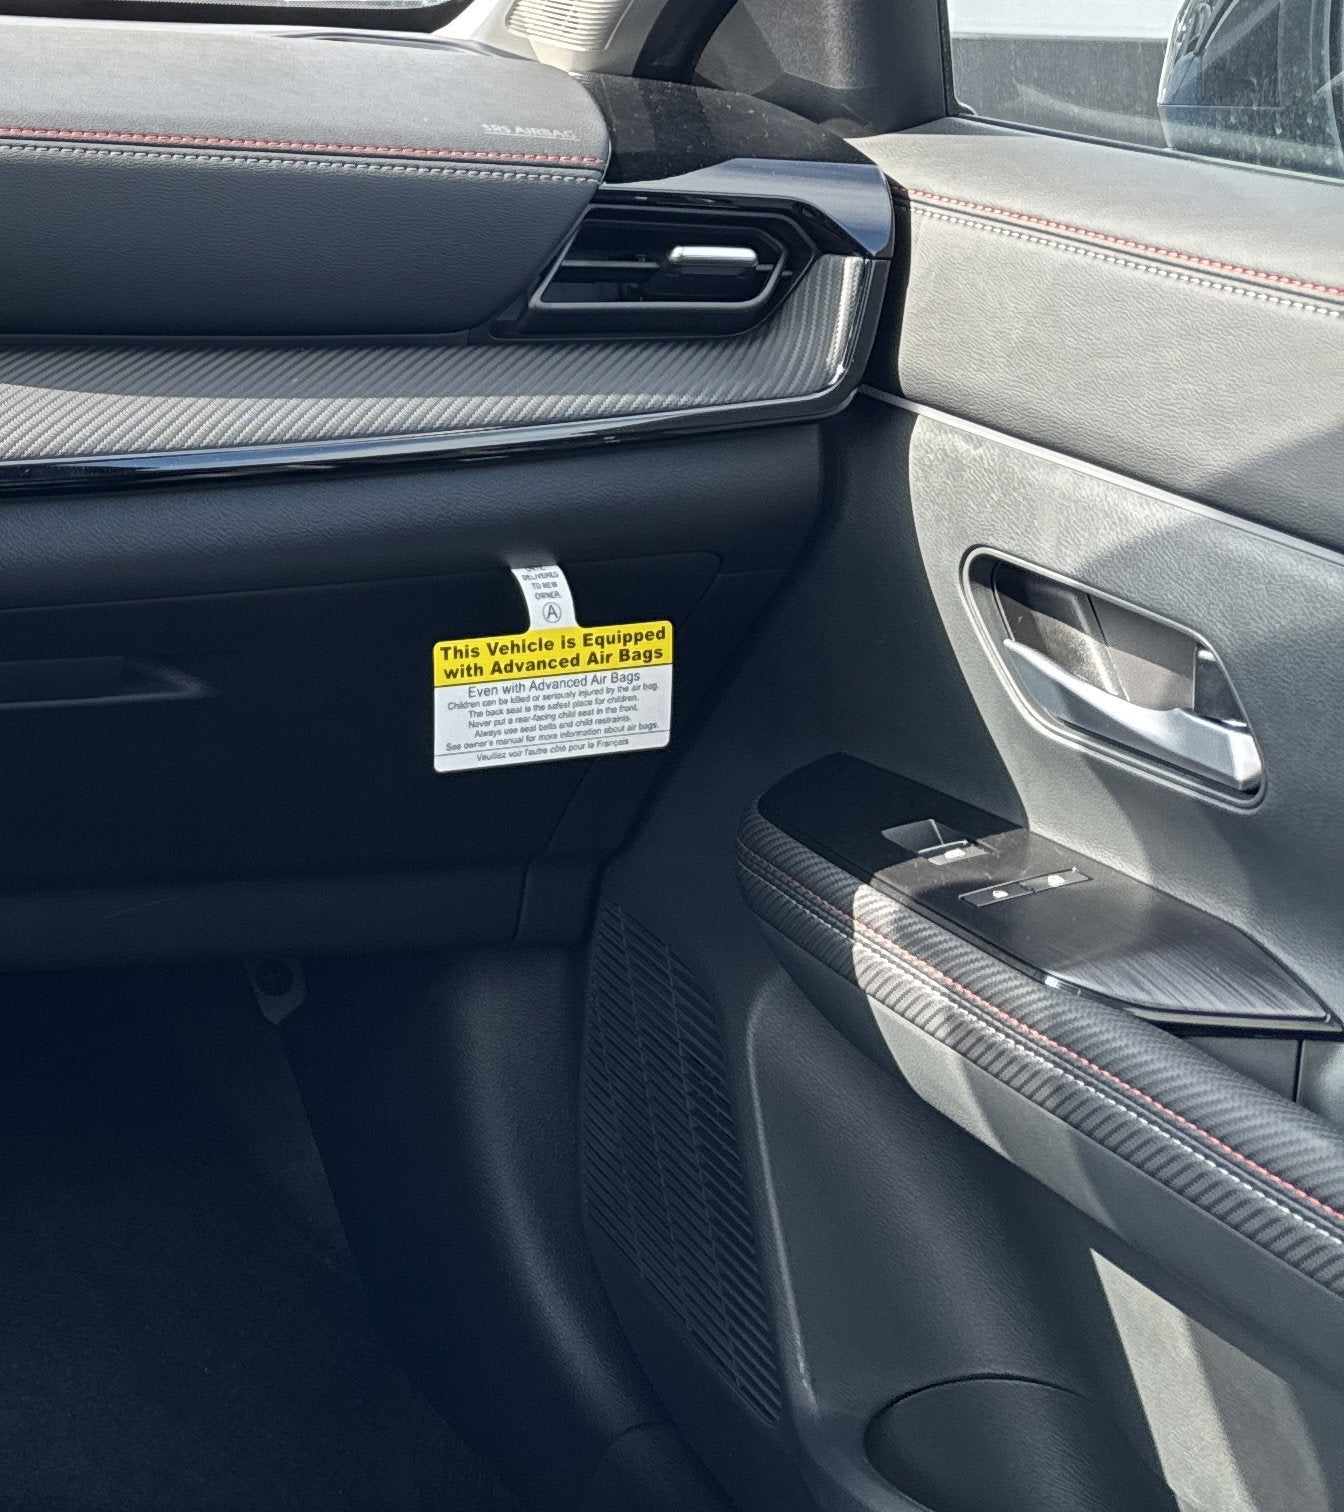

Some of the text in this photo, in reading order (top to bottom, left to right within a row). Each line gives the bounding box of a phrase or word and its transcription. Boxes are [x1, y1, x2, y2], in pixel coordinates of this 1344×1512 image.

[531, 582, 542, 590] TO
[546, 604, 559, 619] A
[440, 625, 667, 662] This Vehicle is Equipped
[443, 646, 664, 680] with Advanced Air Bags
[447, 681, 660, 711] Children can be killed or seriously injured by the air bag.
[468, 671, 641, 699] Even with Advanced Air Bags
[468, 694, 640, 719] The back seat is the safest place for children.
[477, 752, 507, 762] Veuillez
[508, 750, 523, 759] voir
[549, 744, 567, 754] côté
[568, 743, 586, 755] pour
[587, 741, 594, 750] le
[596, 737, 630, 749] Français
